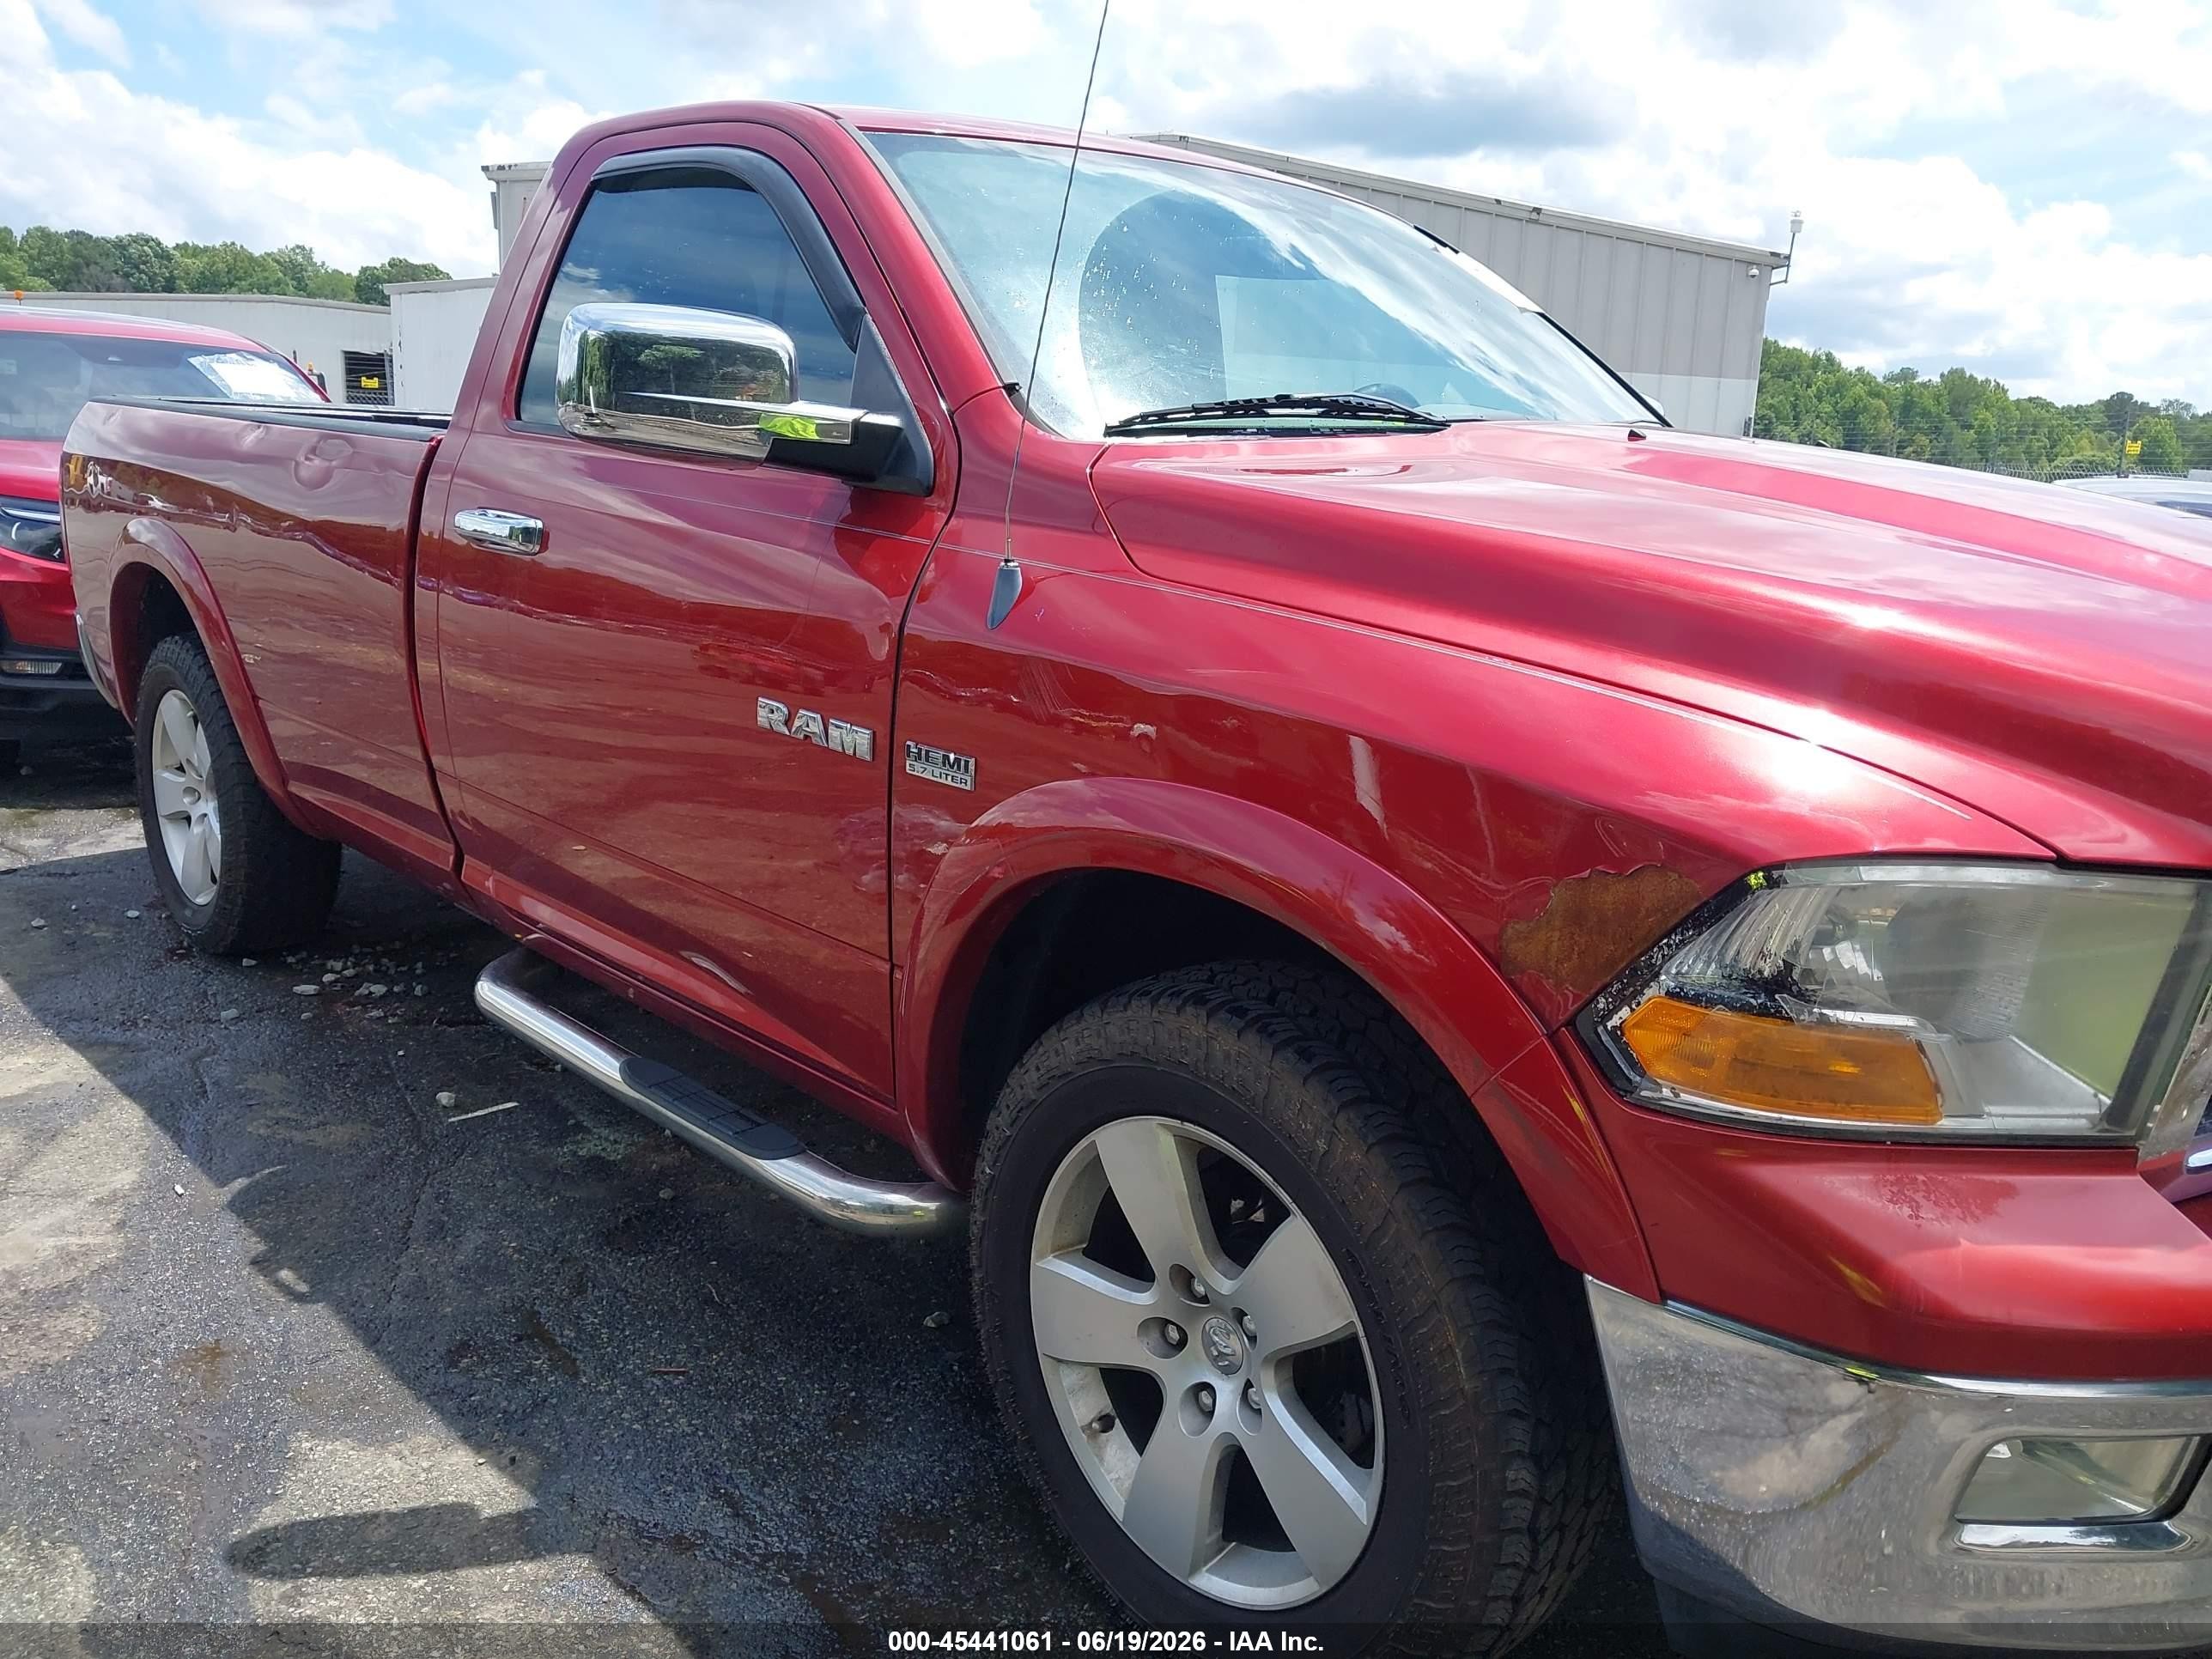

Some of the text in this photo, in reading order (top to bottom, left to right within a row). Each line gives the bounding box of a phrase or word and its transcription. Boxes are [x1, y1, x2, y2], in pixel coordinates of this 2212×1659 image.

[757, 696, 873, 762] RAM
[906, 742, 971, 775] HEMI
[908, 763, 968, 787] 5.7 LITER
